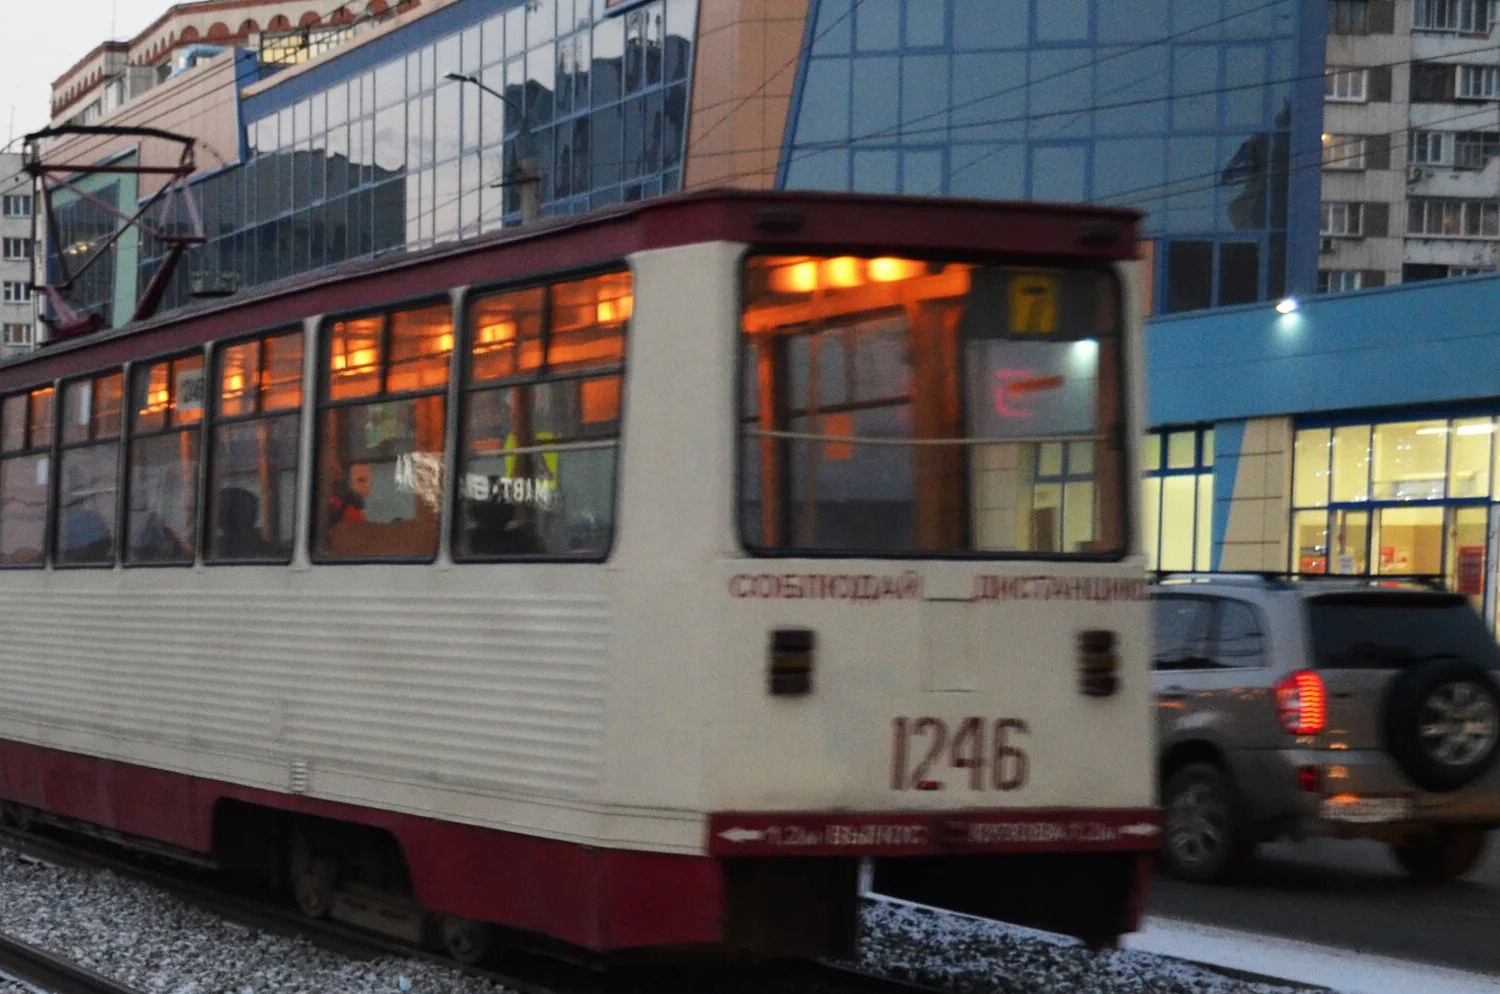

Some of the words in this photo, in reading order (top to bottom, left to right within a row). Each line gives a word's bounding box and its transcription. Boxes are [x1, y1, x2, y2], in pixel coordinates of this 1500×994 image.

[728, 571, 924, 603] СОБЛЮДАЙ
[974, 574, 1148, 604] ДИСТАНЦИЮ
[891, 716, 1029, 791] 1246
